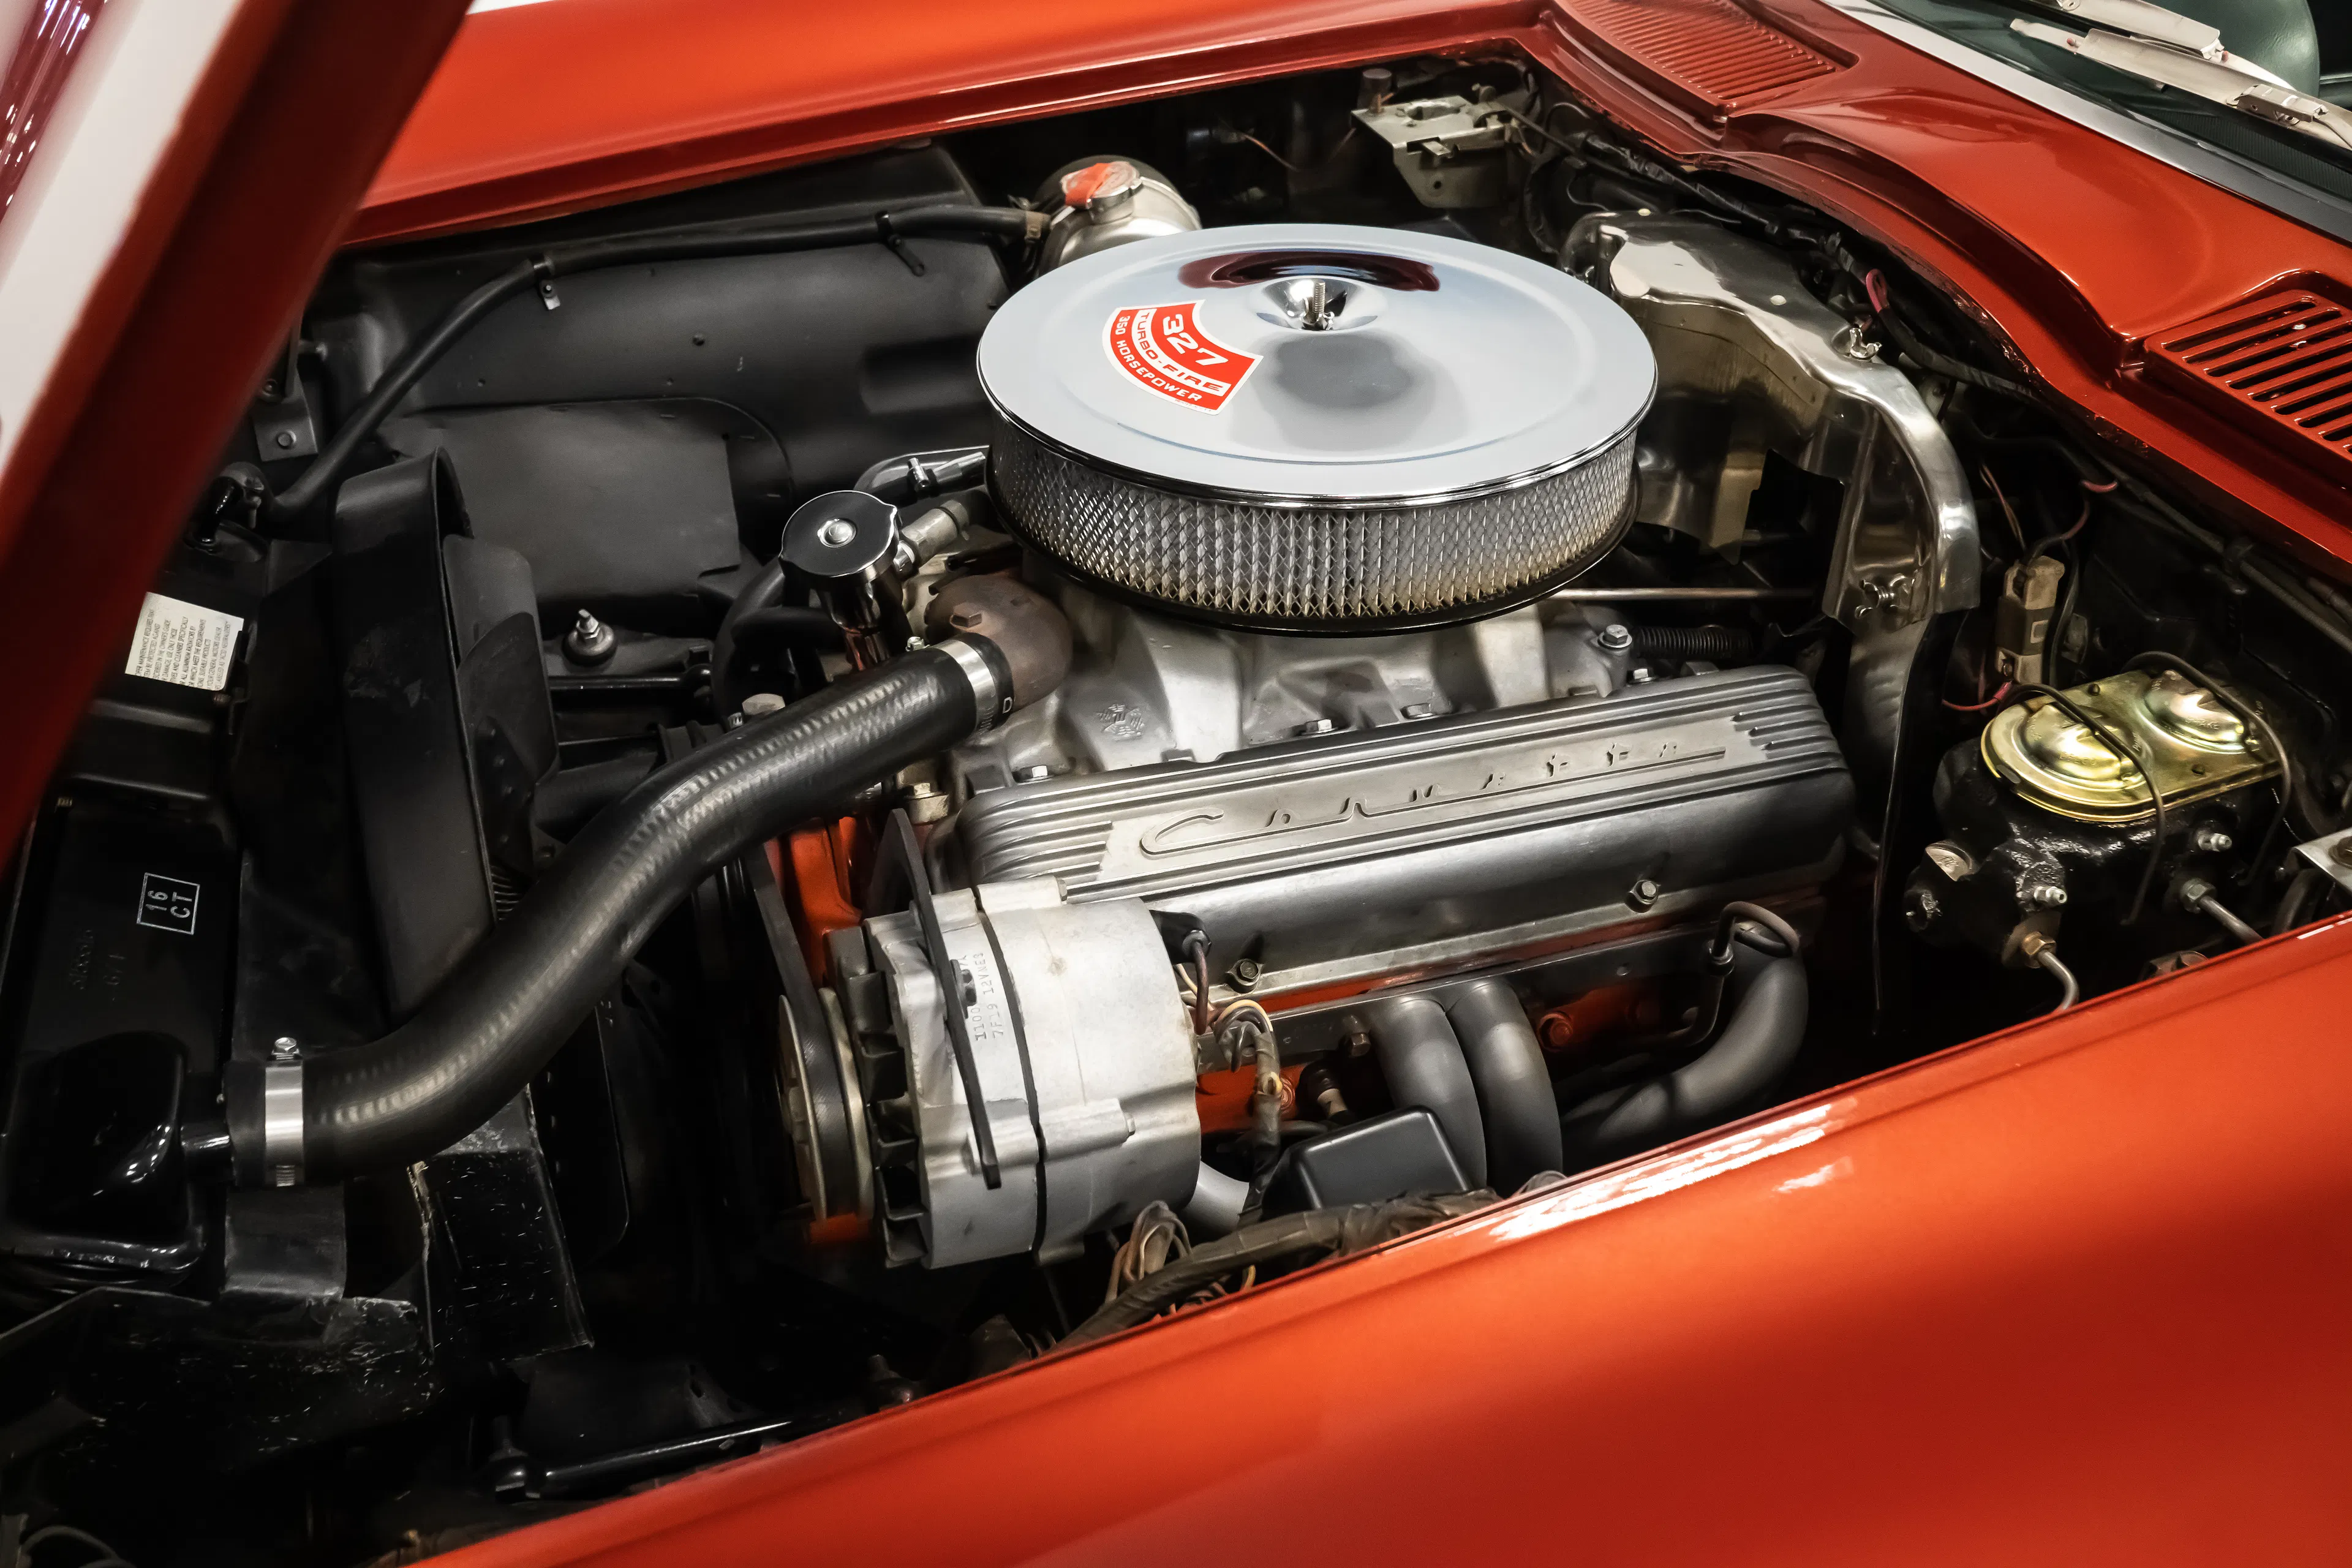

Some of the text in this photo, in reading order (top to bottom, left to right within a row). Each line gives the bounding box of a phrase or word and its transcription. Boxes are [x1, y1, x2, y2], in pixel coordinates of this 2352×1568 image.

[1115, 315, 1131, 335] 350
[1163, 314, 1229, 366] 327
[1116, 340, 1202, 402] HORSEPOWER
[1137, 312, 1223, 391] TURBO-FIRE
[145, 890, 168, 911] 16
[170, 892, 192, 919] CT
